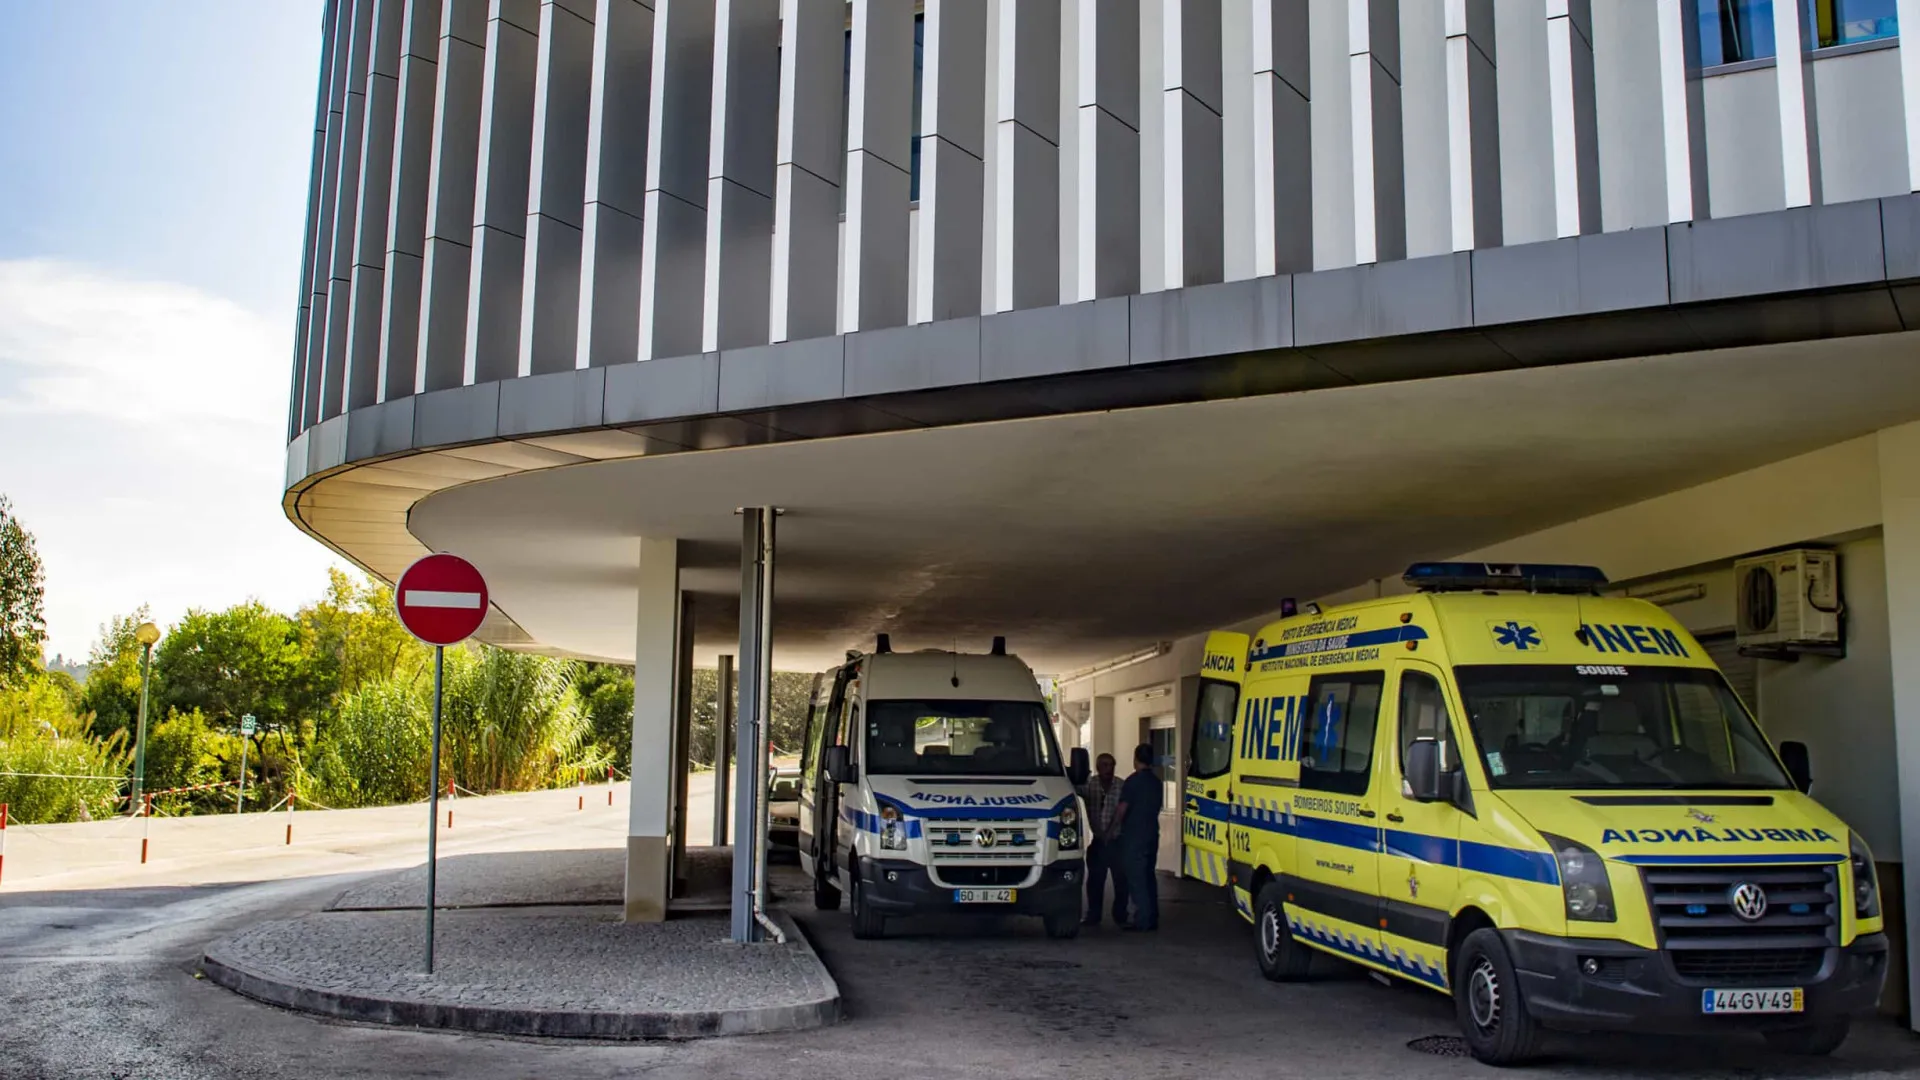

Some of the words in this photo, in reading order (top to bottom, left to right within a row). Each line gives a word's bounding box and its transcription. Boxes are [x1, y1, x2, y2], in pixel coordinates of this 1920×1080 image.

[1580, 624, 1690, 658] INEM
[1284, 656, 1309, 670] NACIONAL
[1310, 655, 1318, 666] DE
[1576, 665, 1629, 676] SOURE
[1240, 695, 1309, 761] INEM
[1293, 795, 1334, 814] BOMBEIROS
[1184, 815, 1217, 843] INEM
[1236, 830, 1251, 853] 112
[1316, 859, 1355, 876] www.inem.pt
